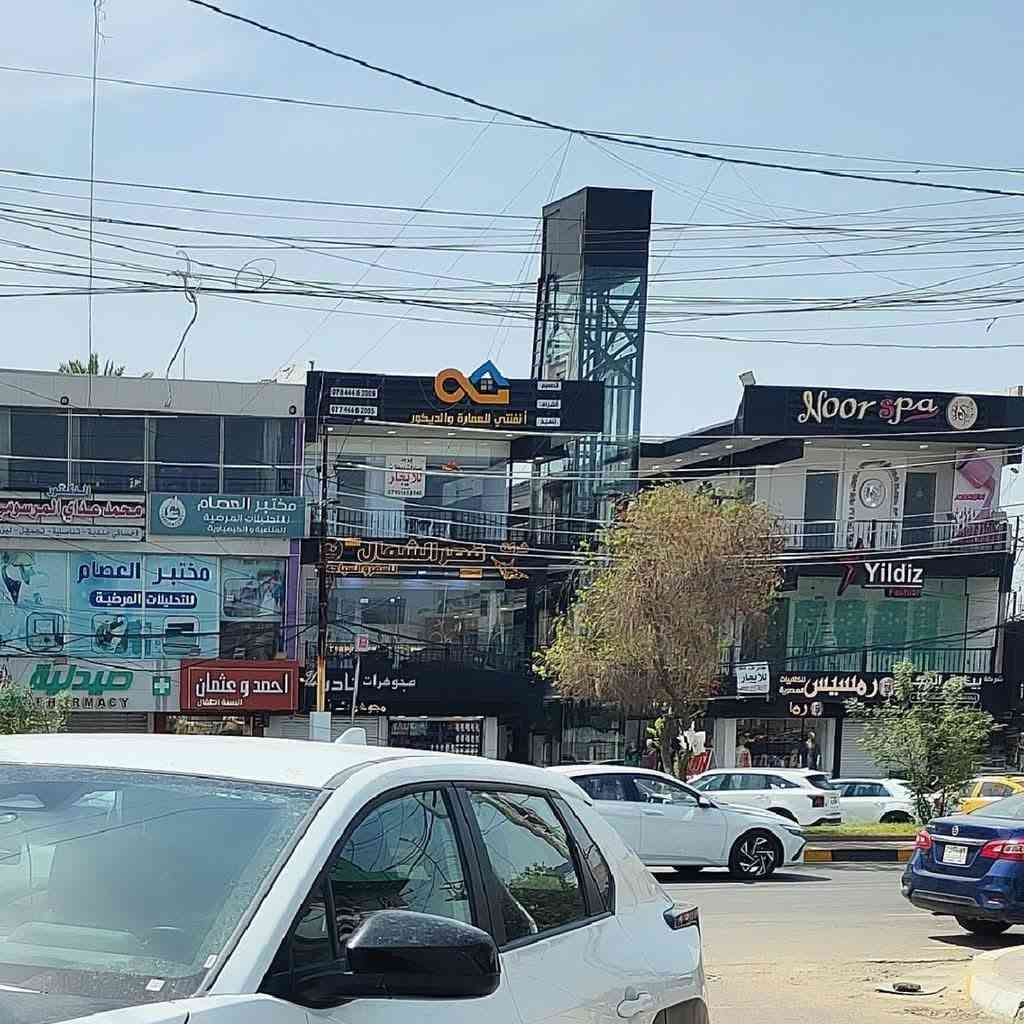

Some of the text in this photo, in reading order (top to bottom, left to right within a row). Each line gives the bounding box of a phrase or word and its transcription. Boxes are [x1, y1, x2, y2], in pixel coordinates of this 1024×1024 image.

[797, 390, 939, 425] Noor spa
[410, 412, 454, 425] والديكور
[457, 412, 491, 425] للعمارة
[102, 501, 145, 518] محمد
[197, 496, 296, 513] مختبر العصام
[203, 513, 290, 525] للتحليلات المرضية
[357, 539, 439, 563] الشمال
[75, 560, 210, 586] مختبر العصام
[864, 562, 924, 583] Yildiz
[95, 591, 195, 607] للتحليلات المرضية
[30, 663, 134, 696] صيدلية
[196, 672, 288, 697] احمد و عثمان
[362, 673, 416, 693] مجوهرات
[805, 675, 878, 698] رمسيس
